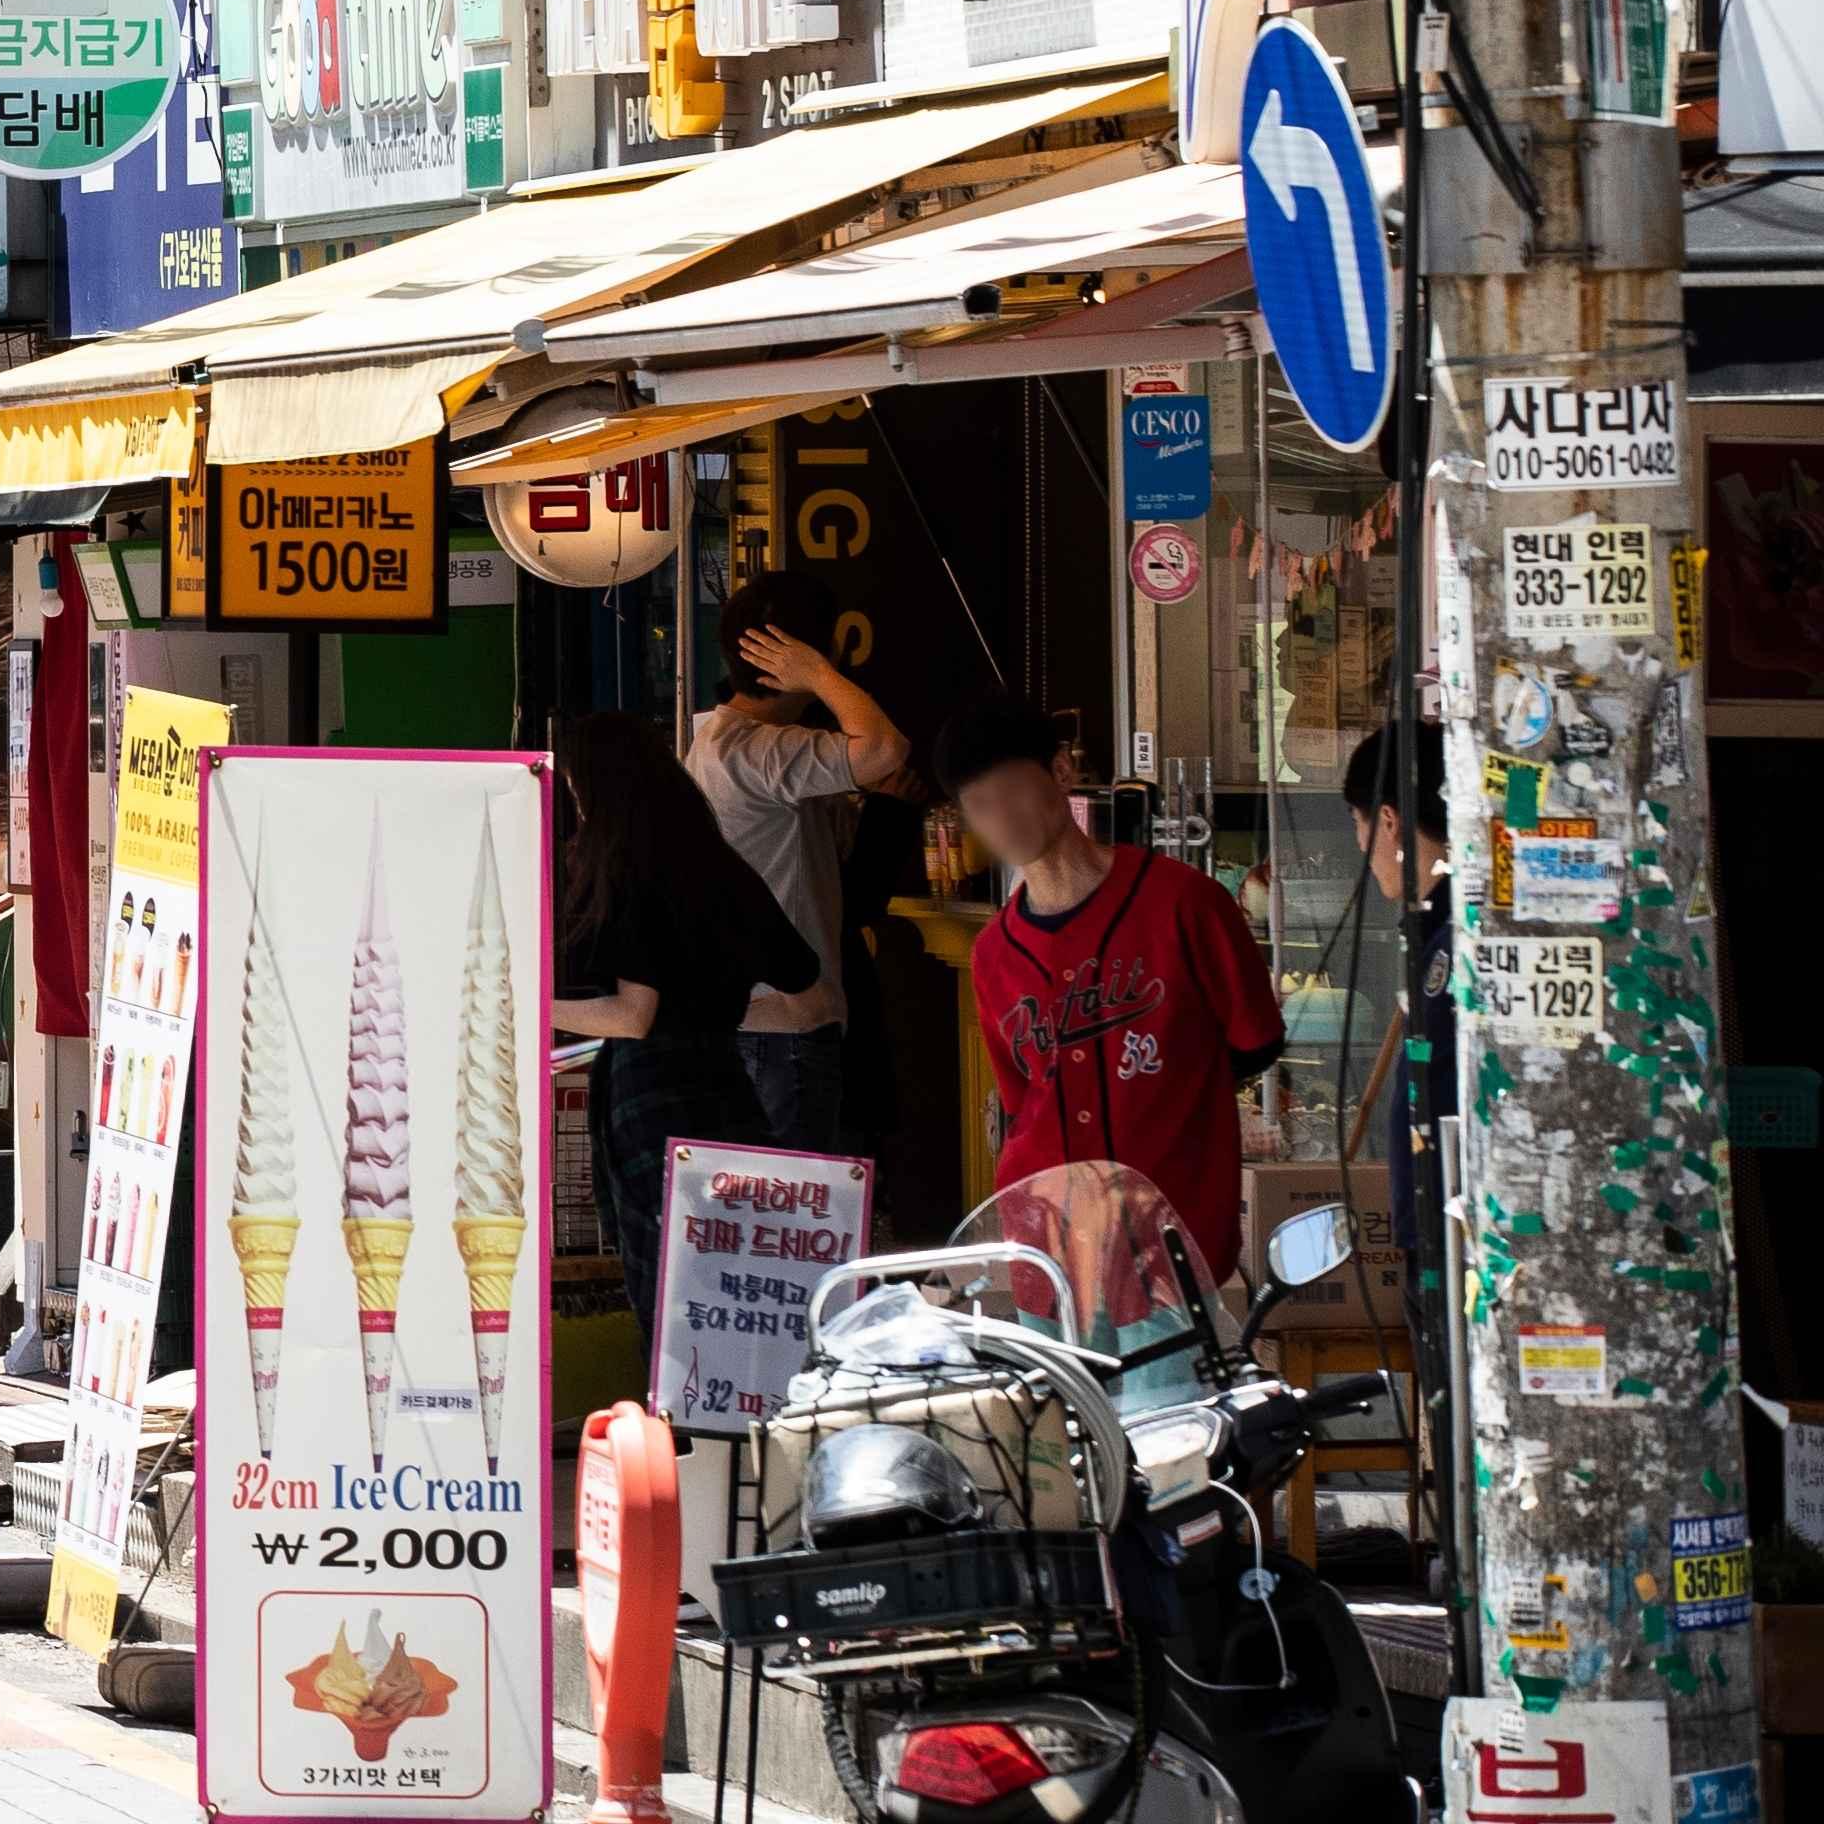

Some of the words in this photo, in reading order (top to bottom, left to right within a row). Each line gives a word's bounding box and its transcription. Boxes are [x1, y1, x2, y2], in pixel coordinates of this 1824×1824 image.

[1130, 408, 1201, 439] CESCO
[239, 486, 416, 532] 아메리카노
[1511, 533, 1573, 563] 현대
[1586, 530, 1645, 561] 인력
[248, 540, 409, 596] 1500원
[1514, 565, 1647, 607] 333-1292
[128, 736, 163, 784] MEGA
[398, 1392, 473, 1411] 카드결제가능
[702, 1378, 734, 1414] 32
[303, 1766, 387, 1789] 3가지맛
[396, 1766, 442, 1788] 선택
